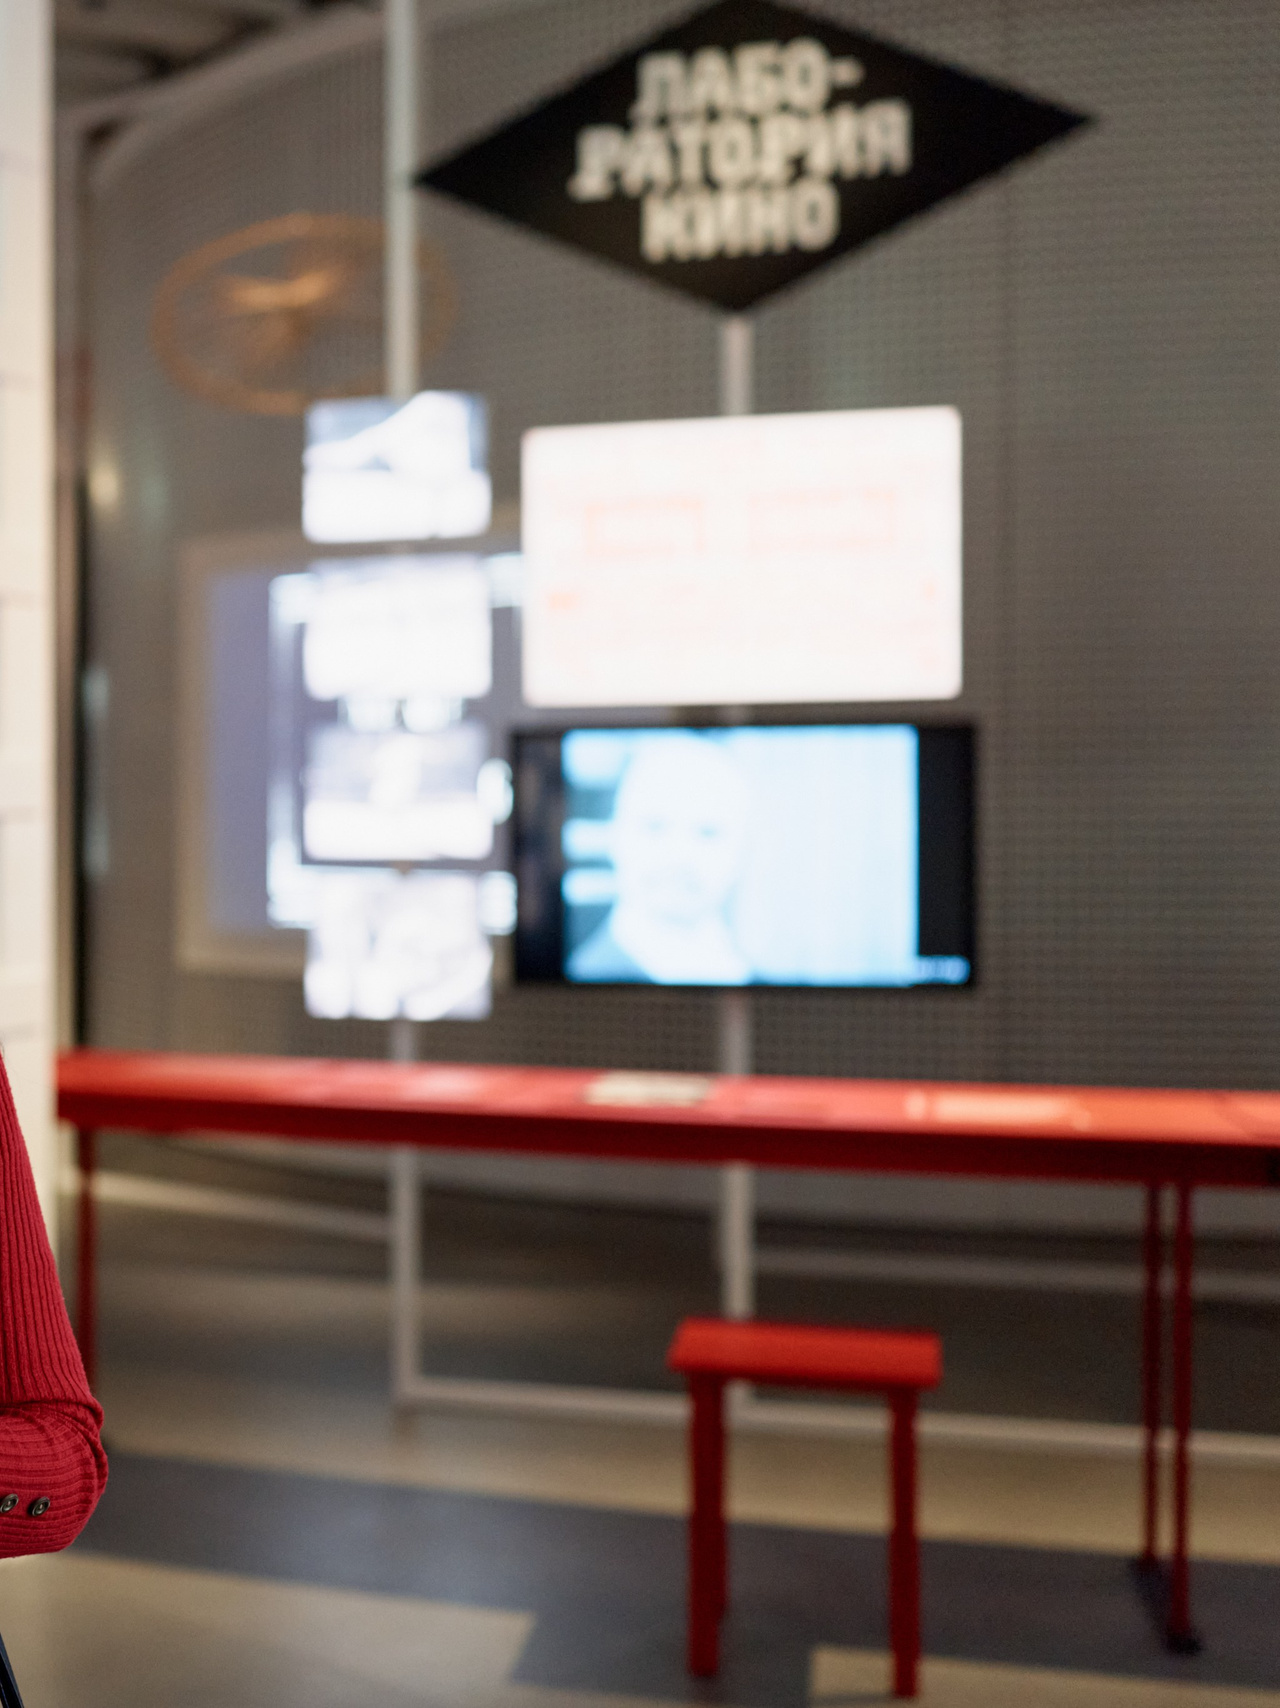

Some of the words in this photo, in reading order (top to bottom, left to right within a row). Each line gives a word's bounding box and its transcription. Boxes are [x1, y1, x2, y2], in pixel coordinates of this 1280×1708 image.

[631, 38, 863, 120] ЛАБО-
[568, 99, 911, 201] РАТОРИЯ
[641, 182, 839, 262] КИНО
